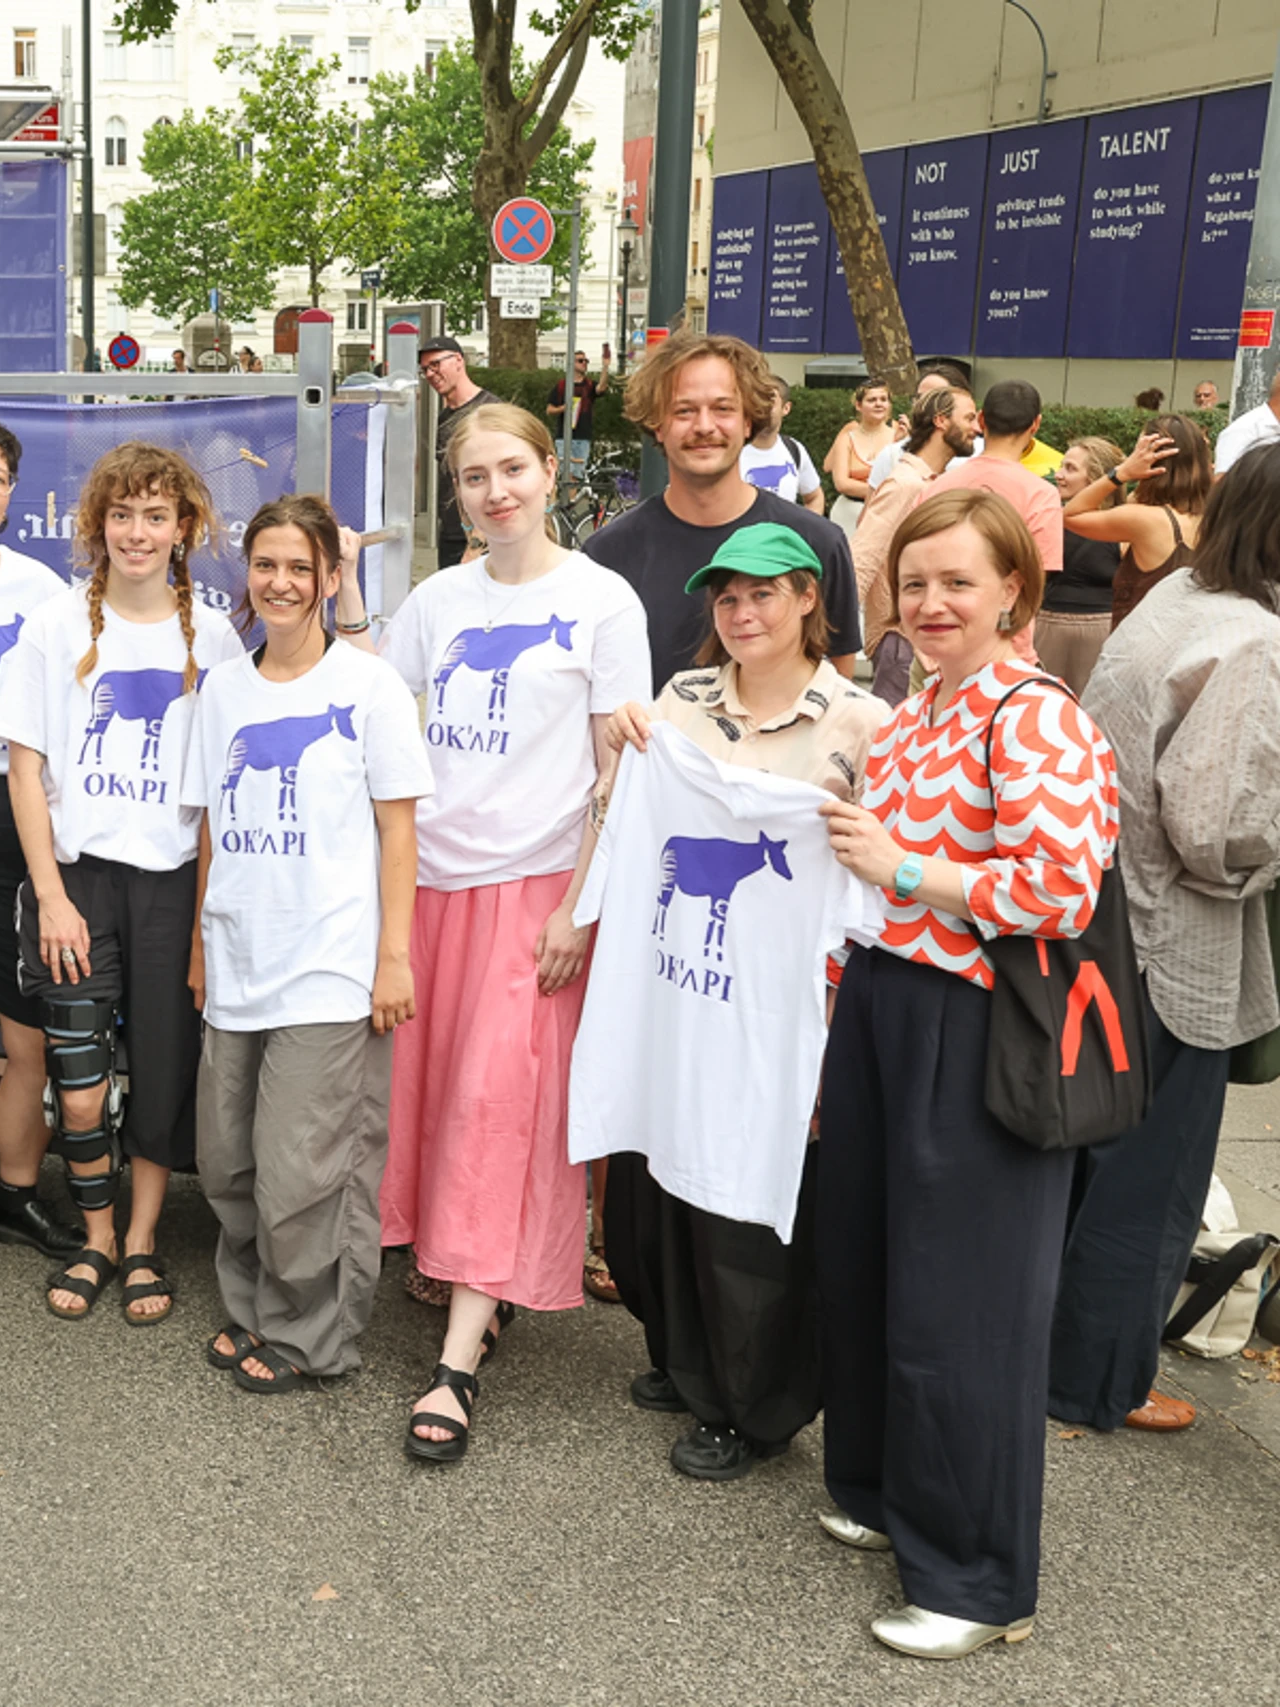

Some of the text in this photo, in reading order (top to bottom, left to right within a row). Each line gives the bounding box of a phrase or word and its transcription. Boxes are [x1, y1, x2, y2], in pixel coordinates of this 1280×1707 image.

[1100, 126, 1171, 159] TALENT
[1000, 149, 1040, 174] JUST
[915, 162, 948, 185] NOT
[1208, 172, 1223, 184] do
[1223, 171, 1245, 185] you
[1093, 183, 1160, 202] do you have
[1207, 191, 1241, 203] what a
[996, 193, 1066, 216] privilege tends
[1092, 201, 1166, 220] to work while
[922, 206, 970, 222] continues
[995, 213, 1062, 231] to be invisible
[911, 227, 955, 242] with who
[1090, 222, 1143, 240] studying?
[909, 248, 957, 265] you know.
[989, 287, 1049, 302] do you know
[507, 301, 534, 315] Ende
[987, 305, 1019, 321] yours?
